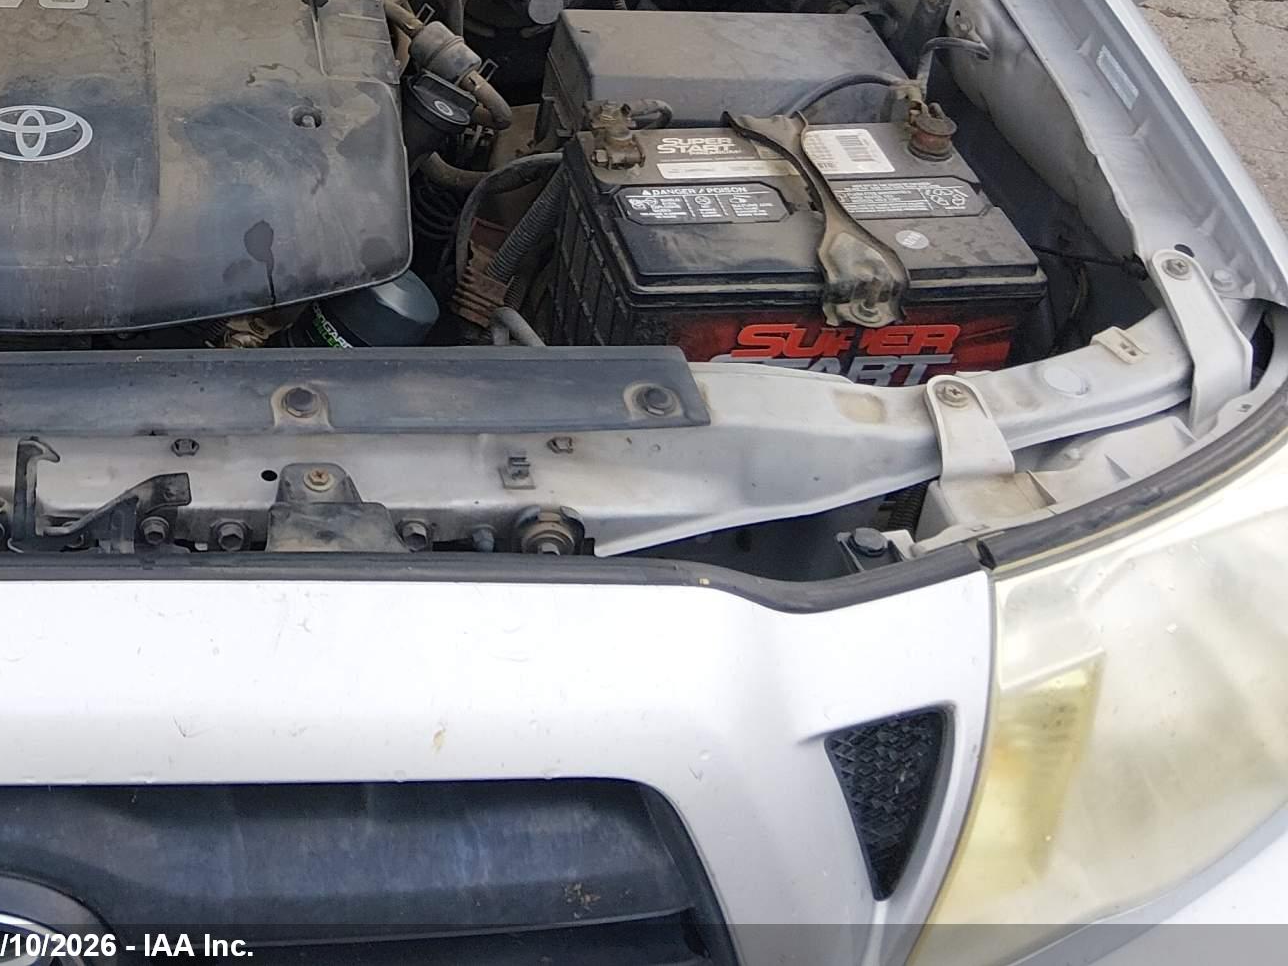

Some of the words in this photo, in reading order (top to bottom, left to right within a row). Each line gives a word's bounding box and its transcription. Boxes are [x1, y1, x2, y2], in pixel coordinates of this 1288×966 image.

[661, 137, 733, 146] SUPER
[656, 144, 736, 154] START
[652, 188, 697, 196] DANGER
